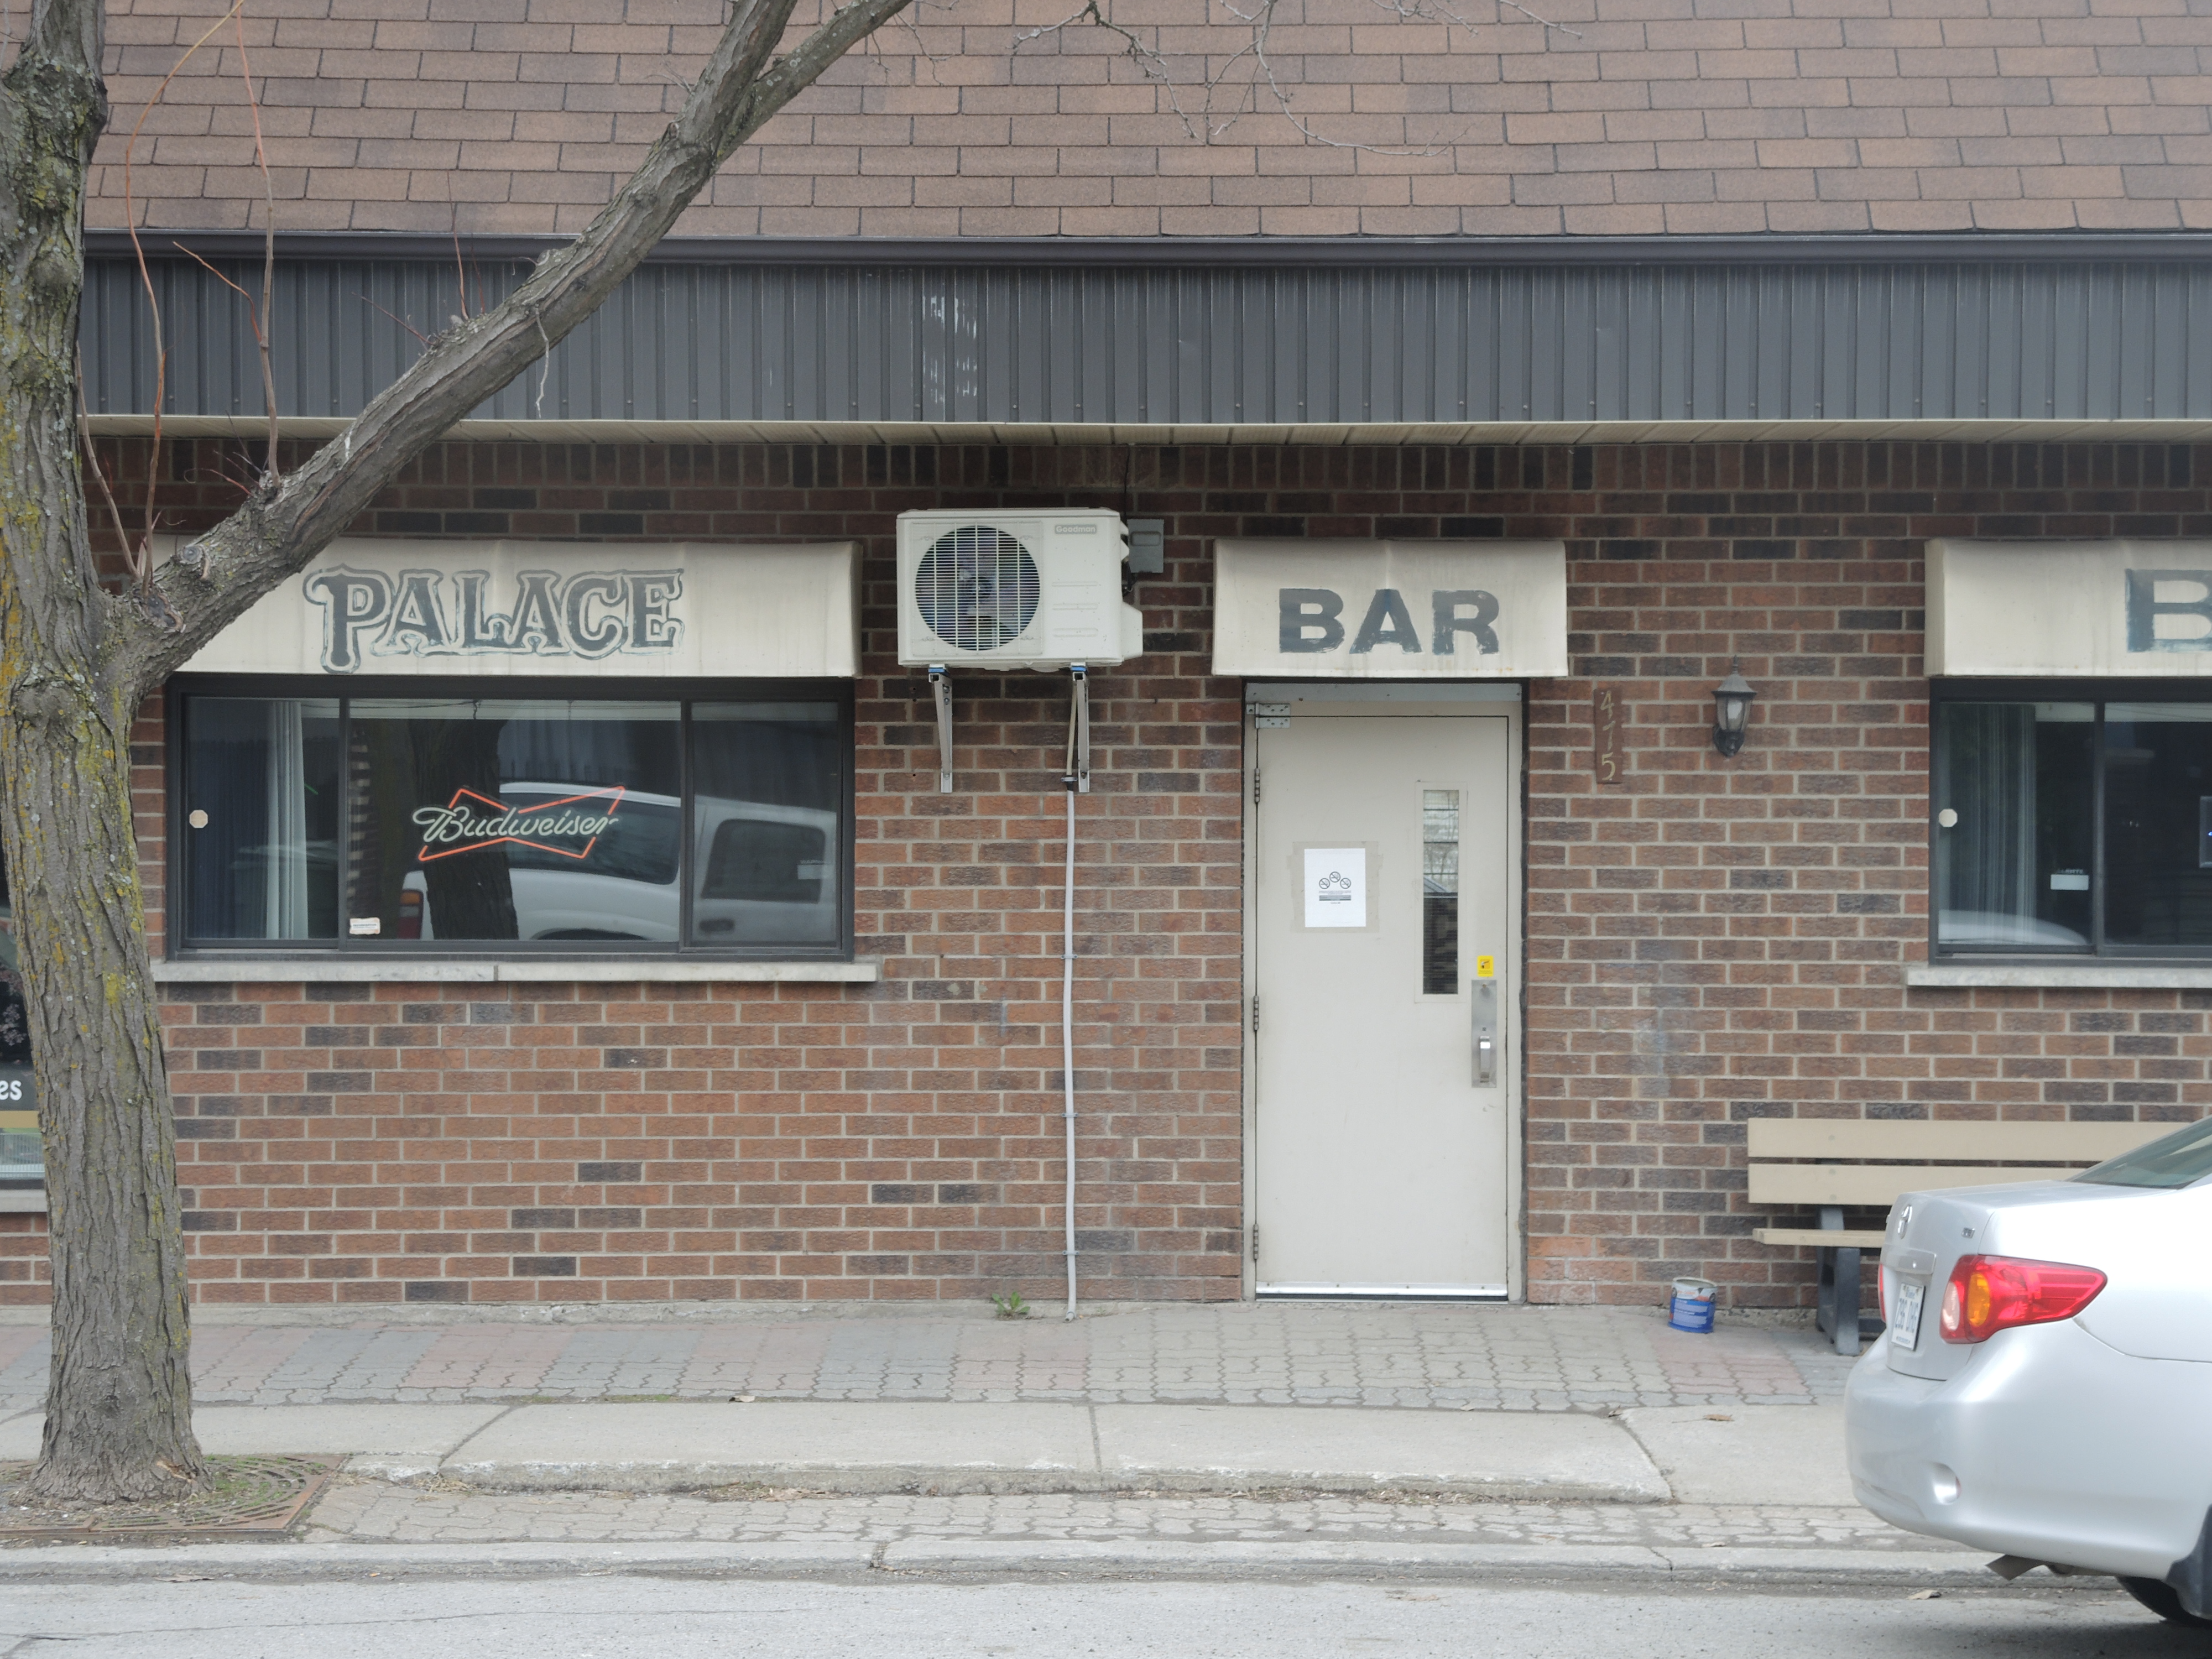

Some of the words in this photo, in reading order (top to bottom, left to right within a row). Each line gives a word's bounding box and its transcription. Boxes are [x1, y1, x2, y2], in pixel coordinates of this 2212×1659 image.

[303, 564, 685, 674] PALACE
[1279, 588, 1500, 655] BAR
[413, 806, 619, 842] Budweiser
